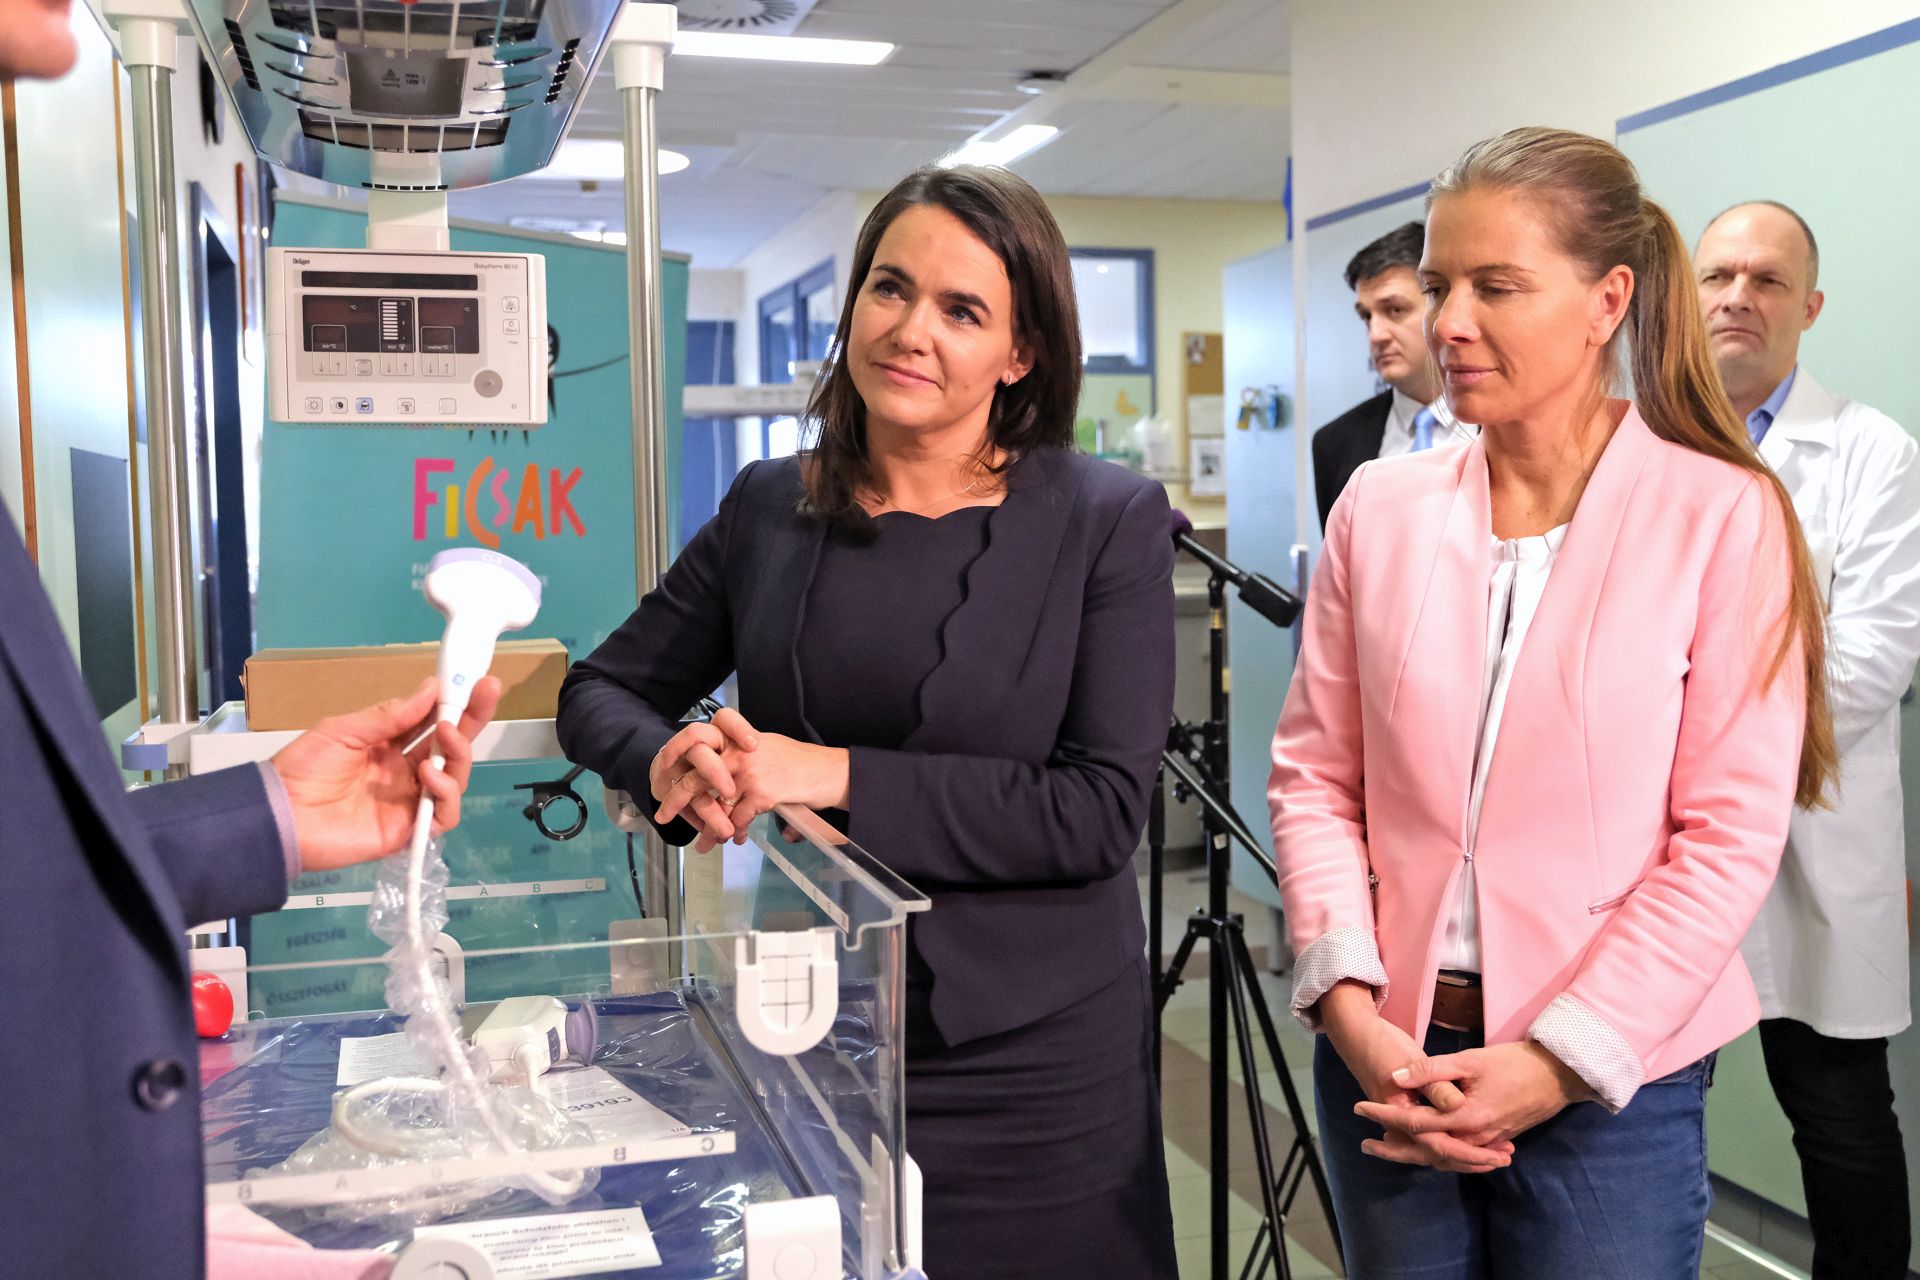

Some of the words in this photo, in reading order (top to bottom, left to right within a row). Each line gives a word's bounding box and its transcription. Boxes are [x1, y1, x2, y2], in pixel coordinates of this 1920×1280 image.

[413, 455, 587, 549] FICSAK
[316, 896, 325, 906] B
[480, 886, 489, 896] A
[533, 883, 541, 893] B
[585, 880, 594, 890] C
